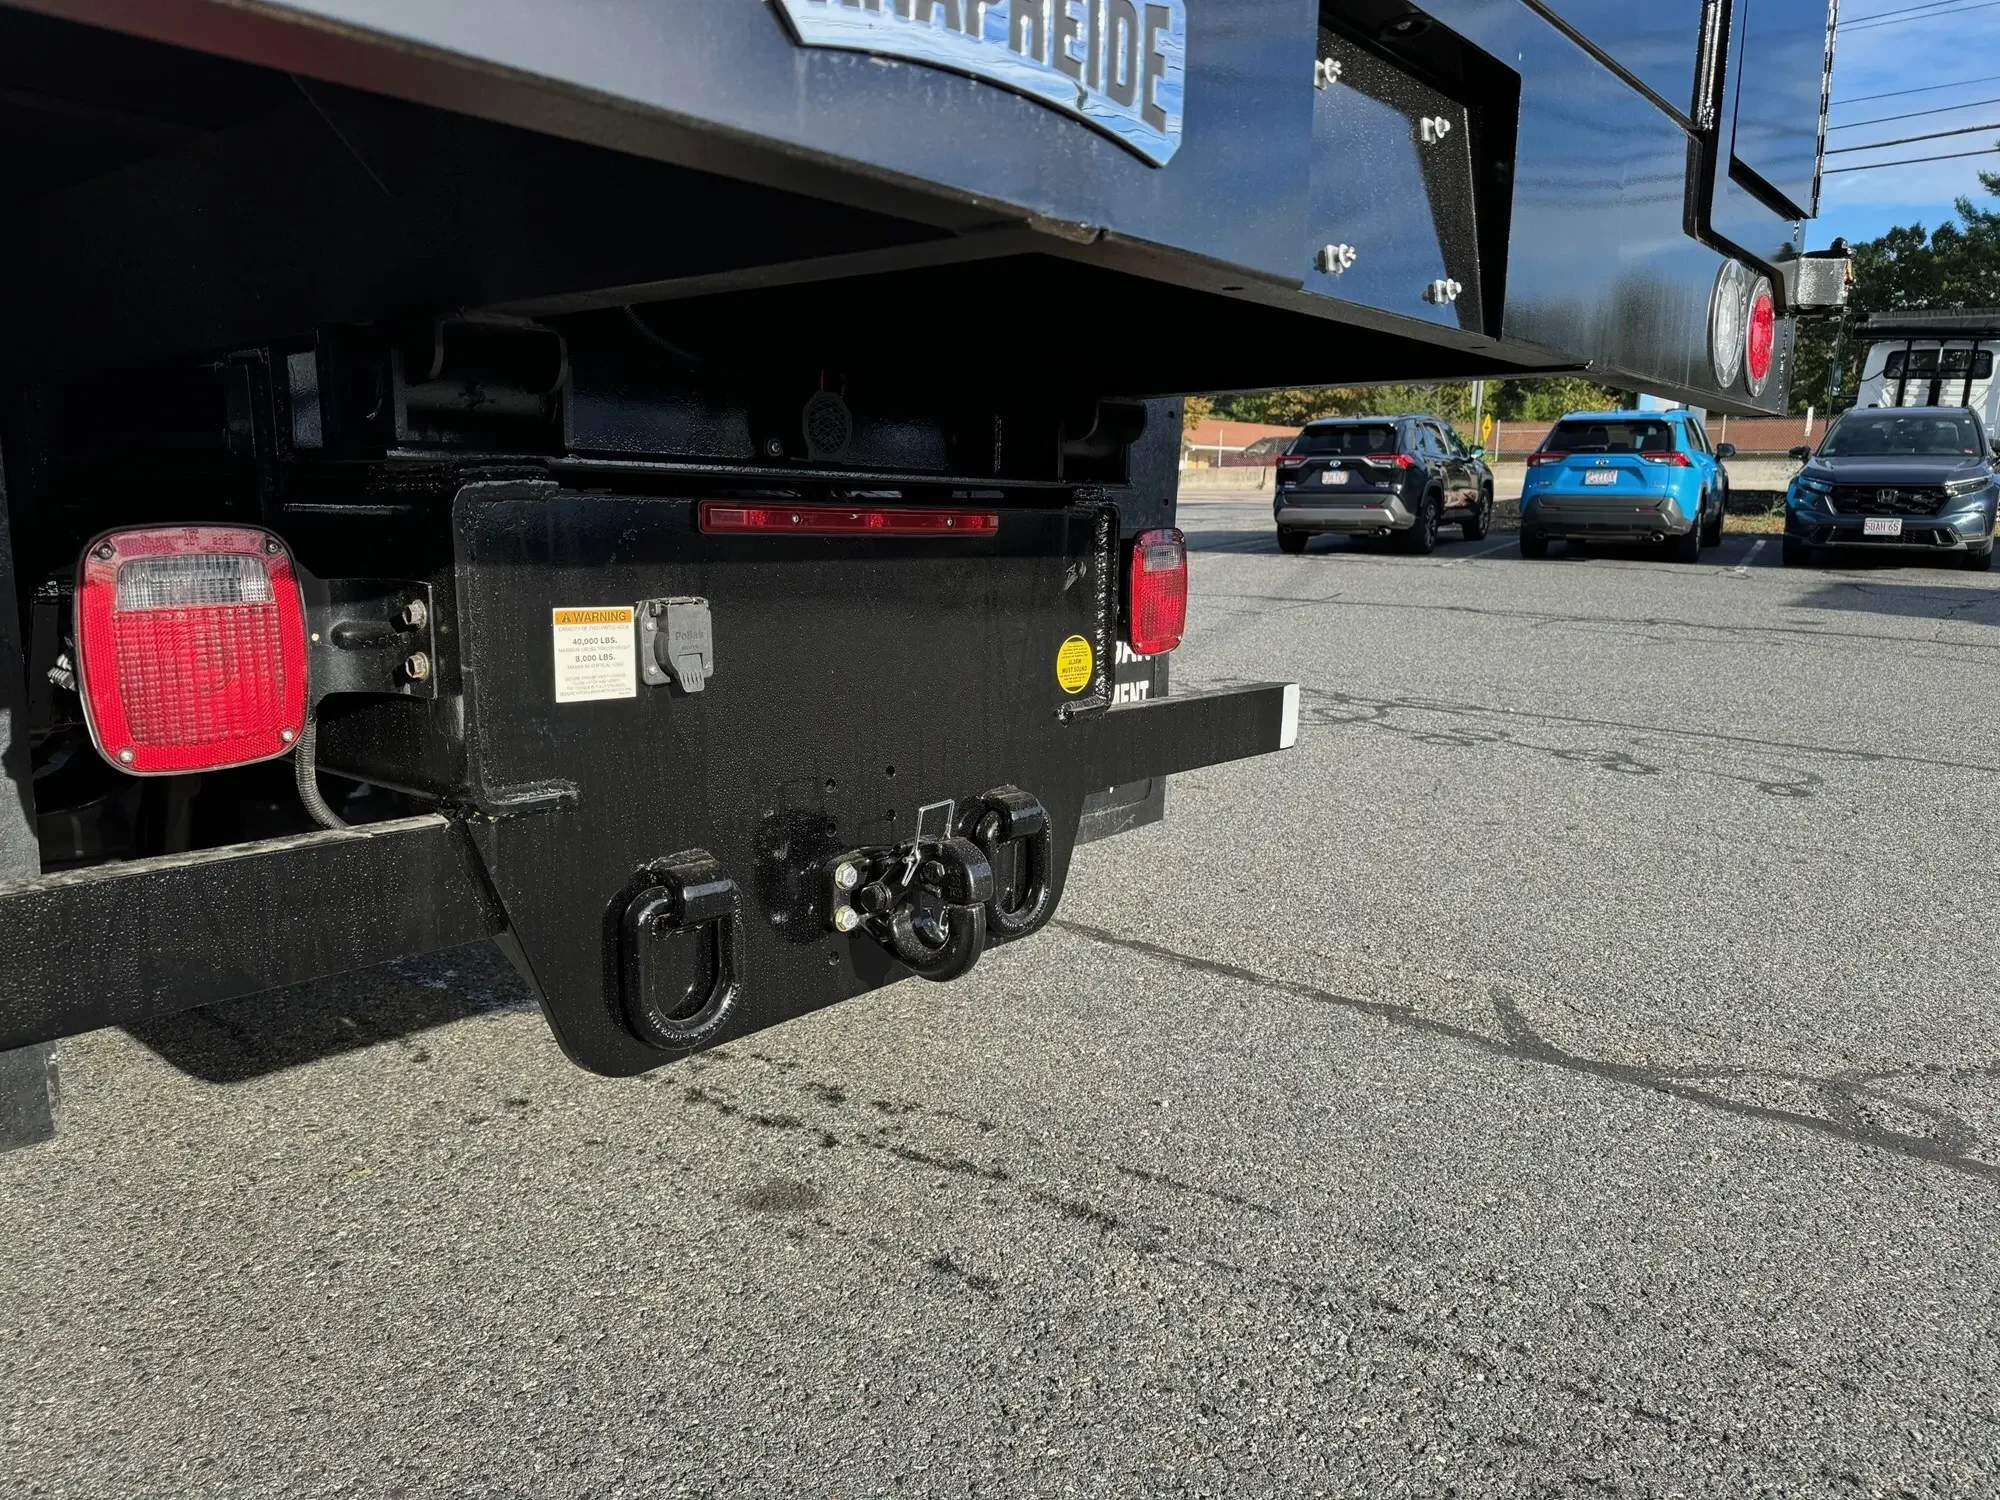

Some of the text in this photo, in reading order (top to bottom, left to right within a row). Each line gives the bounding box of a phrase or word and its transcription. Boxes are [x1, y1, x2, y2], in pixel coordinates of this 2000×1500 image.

[574, 611, 626, 623] WARNING
[572, 636, 618, 646] 40,000 LBS.
[575, 653, 616, 663] 8,000 LBS.
